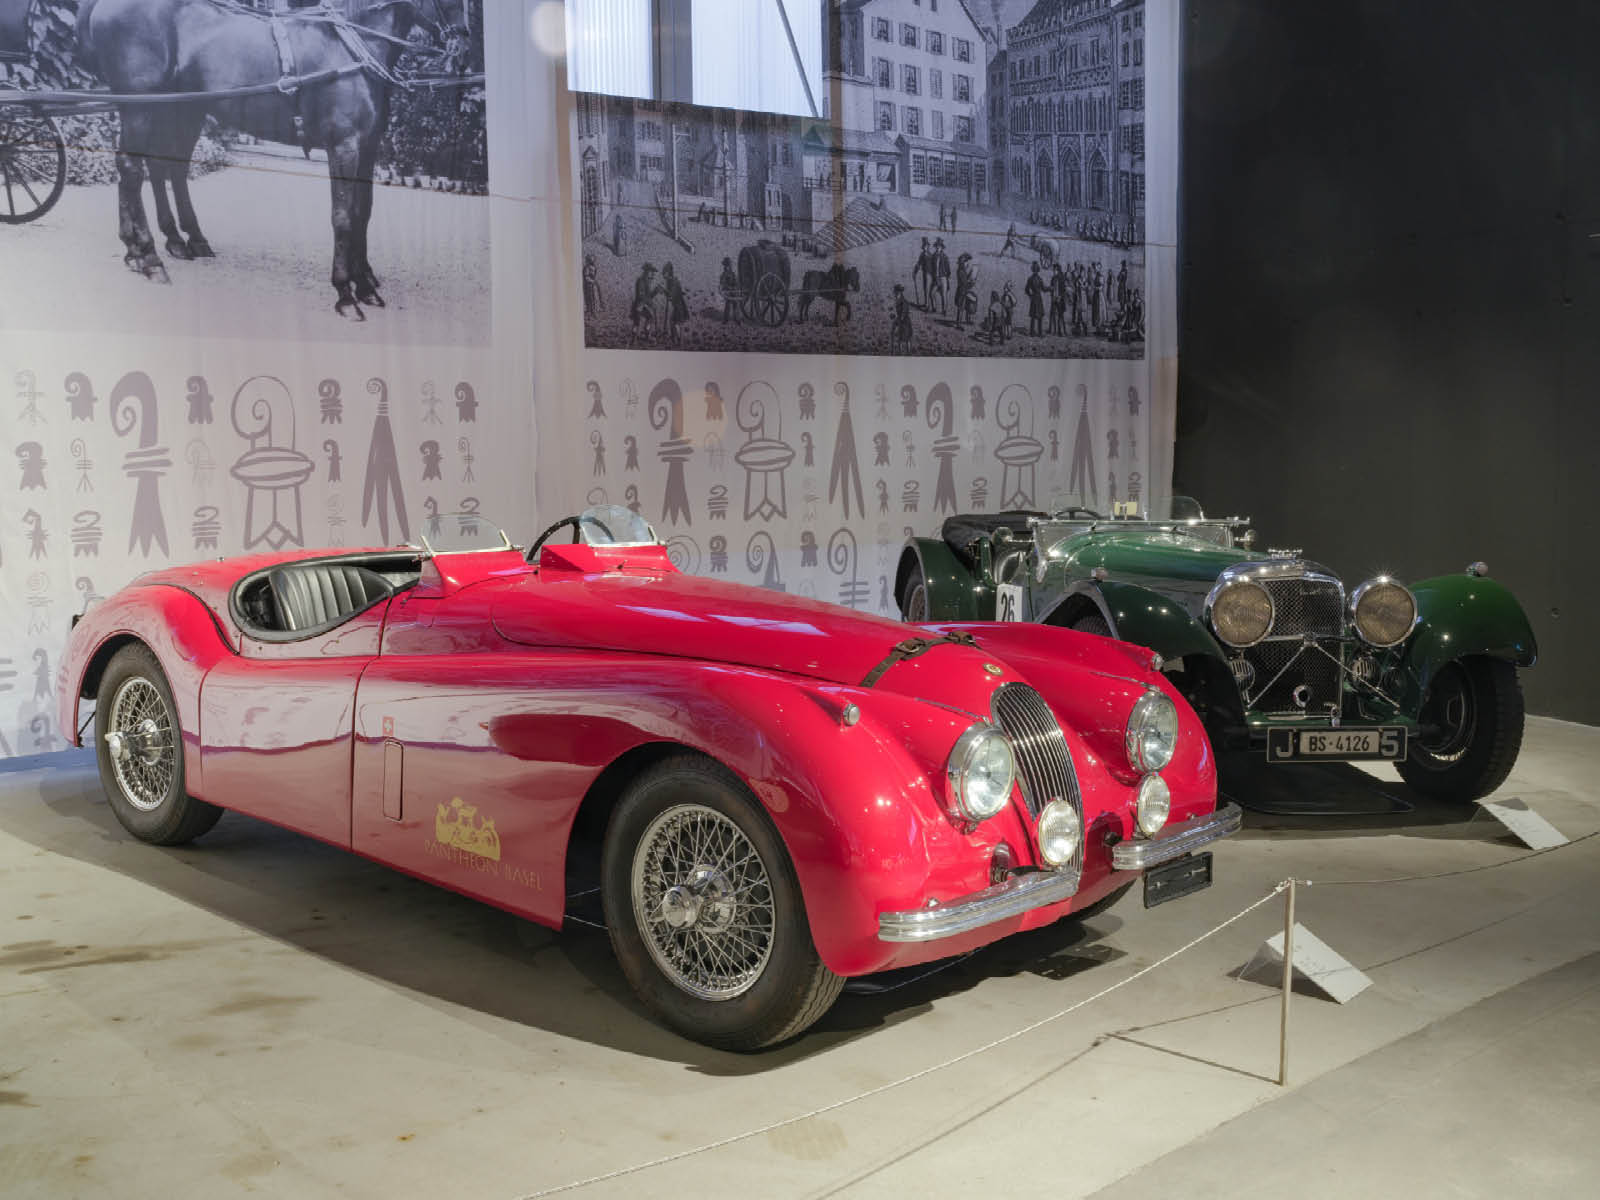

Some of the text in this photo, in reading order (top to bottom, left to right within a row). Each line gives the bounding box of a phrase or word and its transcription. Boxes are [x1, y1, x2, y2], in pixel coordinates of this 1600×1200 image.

[1001, 592, 1015, 622] 26
[1275, 730, 1294, 758] J
[424, 839, 544, 891] PANTHEON BASEL
